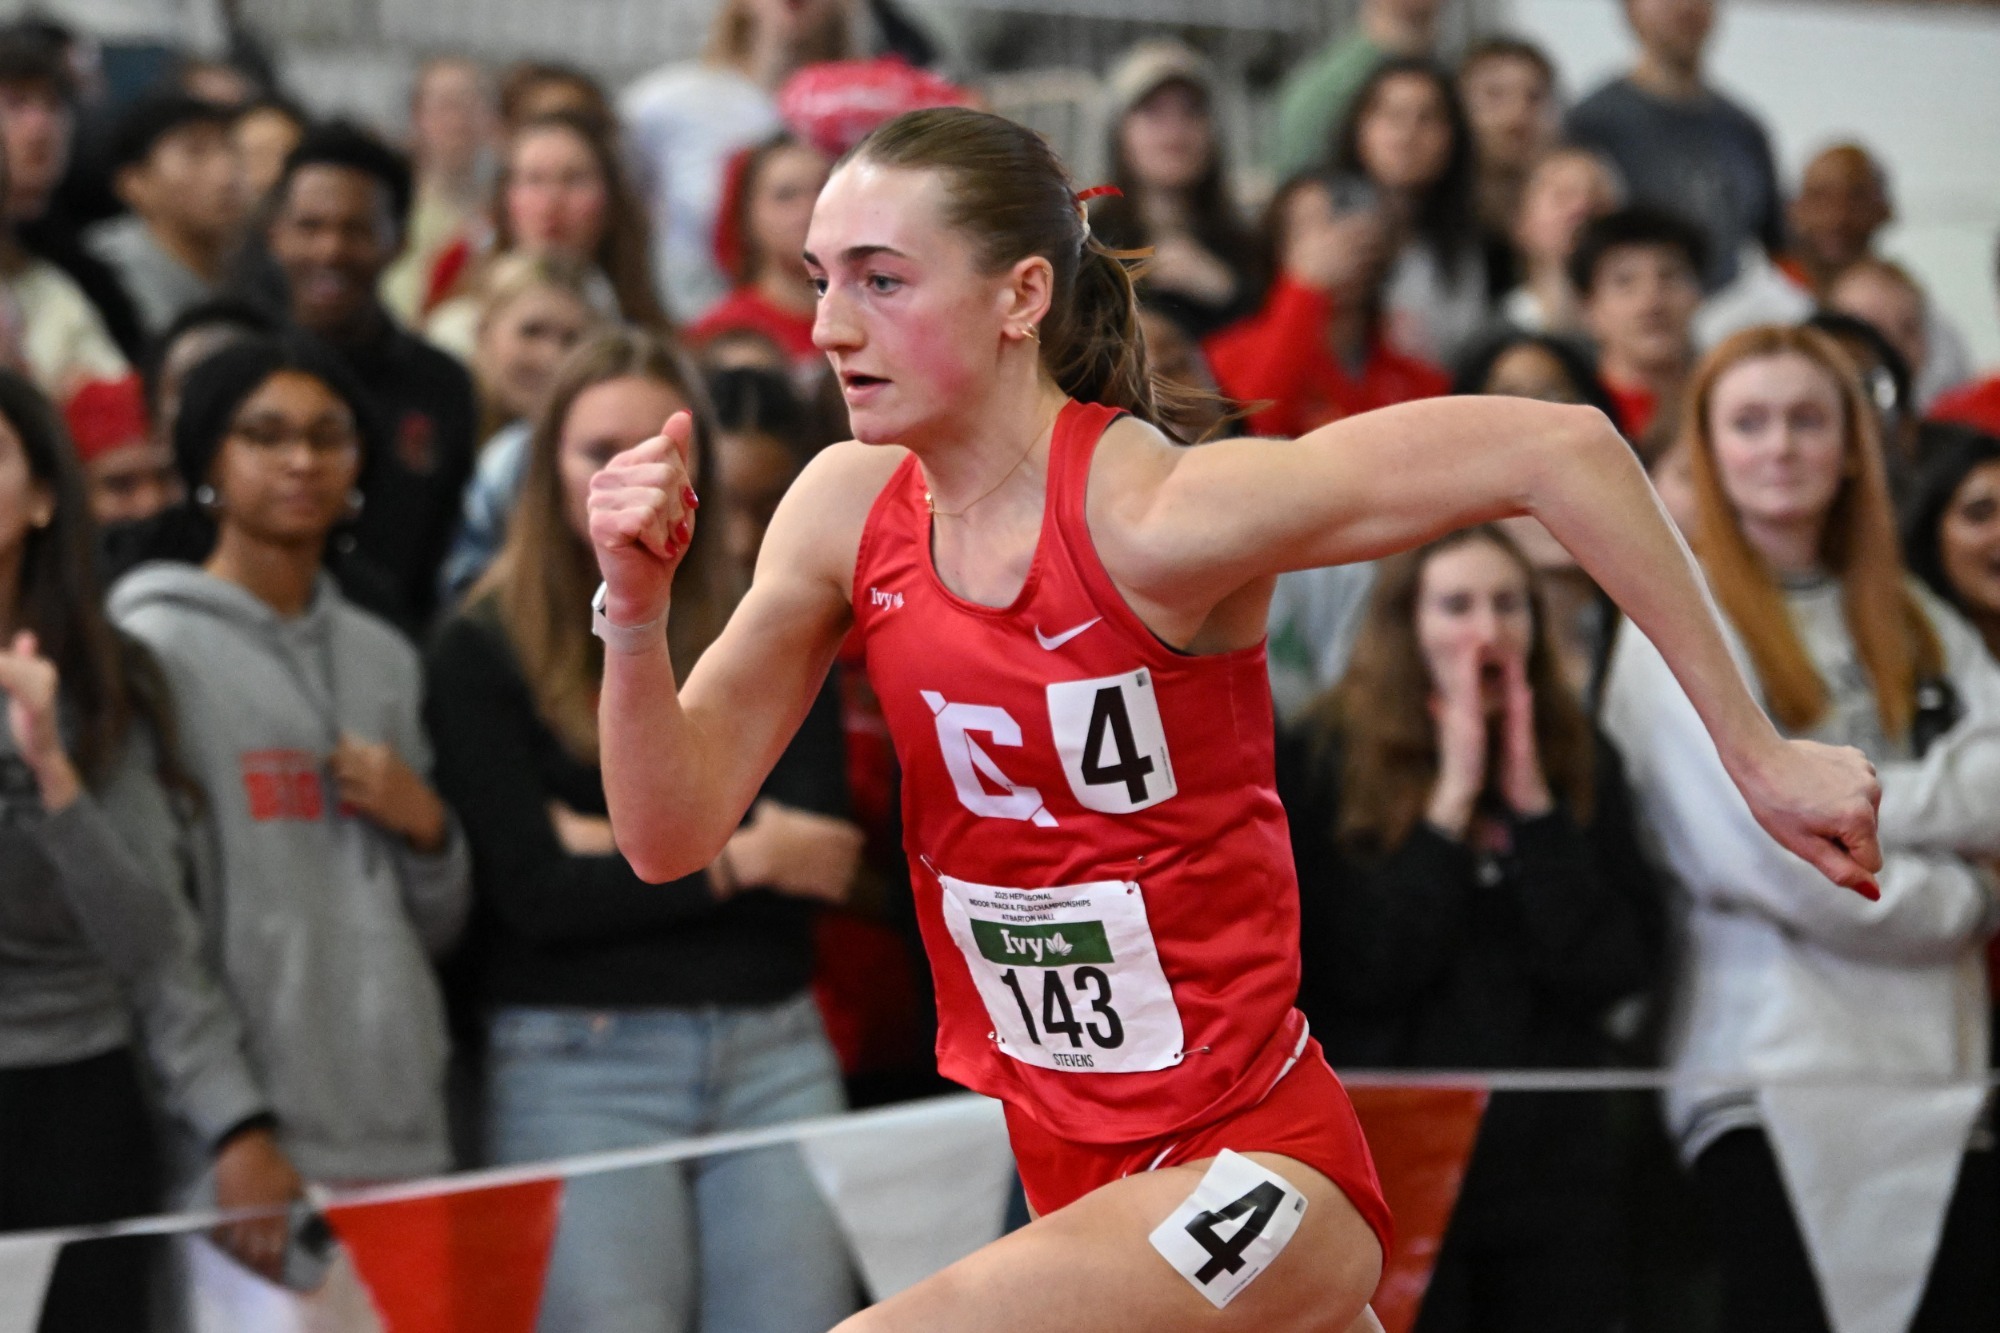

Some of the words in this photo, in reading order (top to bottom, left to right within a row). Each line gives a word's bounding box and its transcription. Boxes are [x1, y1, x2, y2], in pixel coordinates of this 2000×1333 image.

[870, 587, 893, 612] Ivy
[1081, 685, 1155, 805] 4
[990, 902, 1009, 911] TRACK
[1034, 899, 1091, 912] CHAMPIONSHIPS
[994, 891, 1008, 900] 2025
[1010, 914, 1036, 923] BARTON
[1037, 913, 1055, 921] HALL
[1000, 929, 1044, 963] Ivy
[1000, 965, 1125, 1050] 143
[1053, 1053, 1094, 1068] STEVENS
[1184, 1180, 1286, 1286] 4
